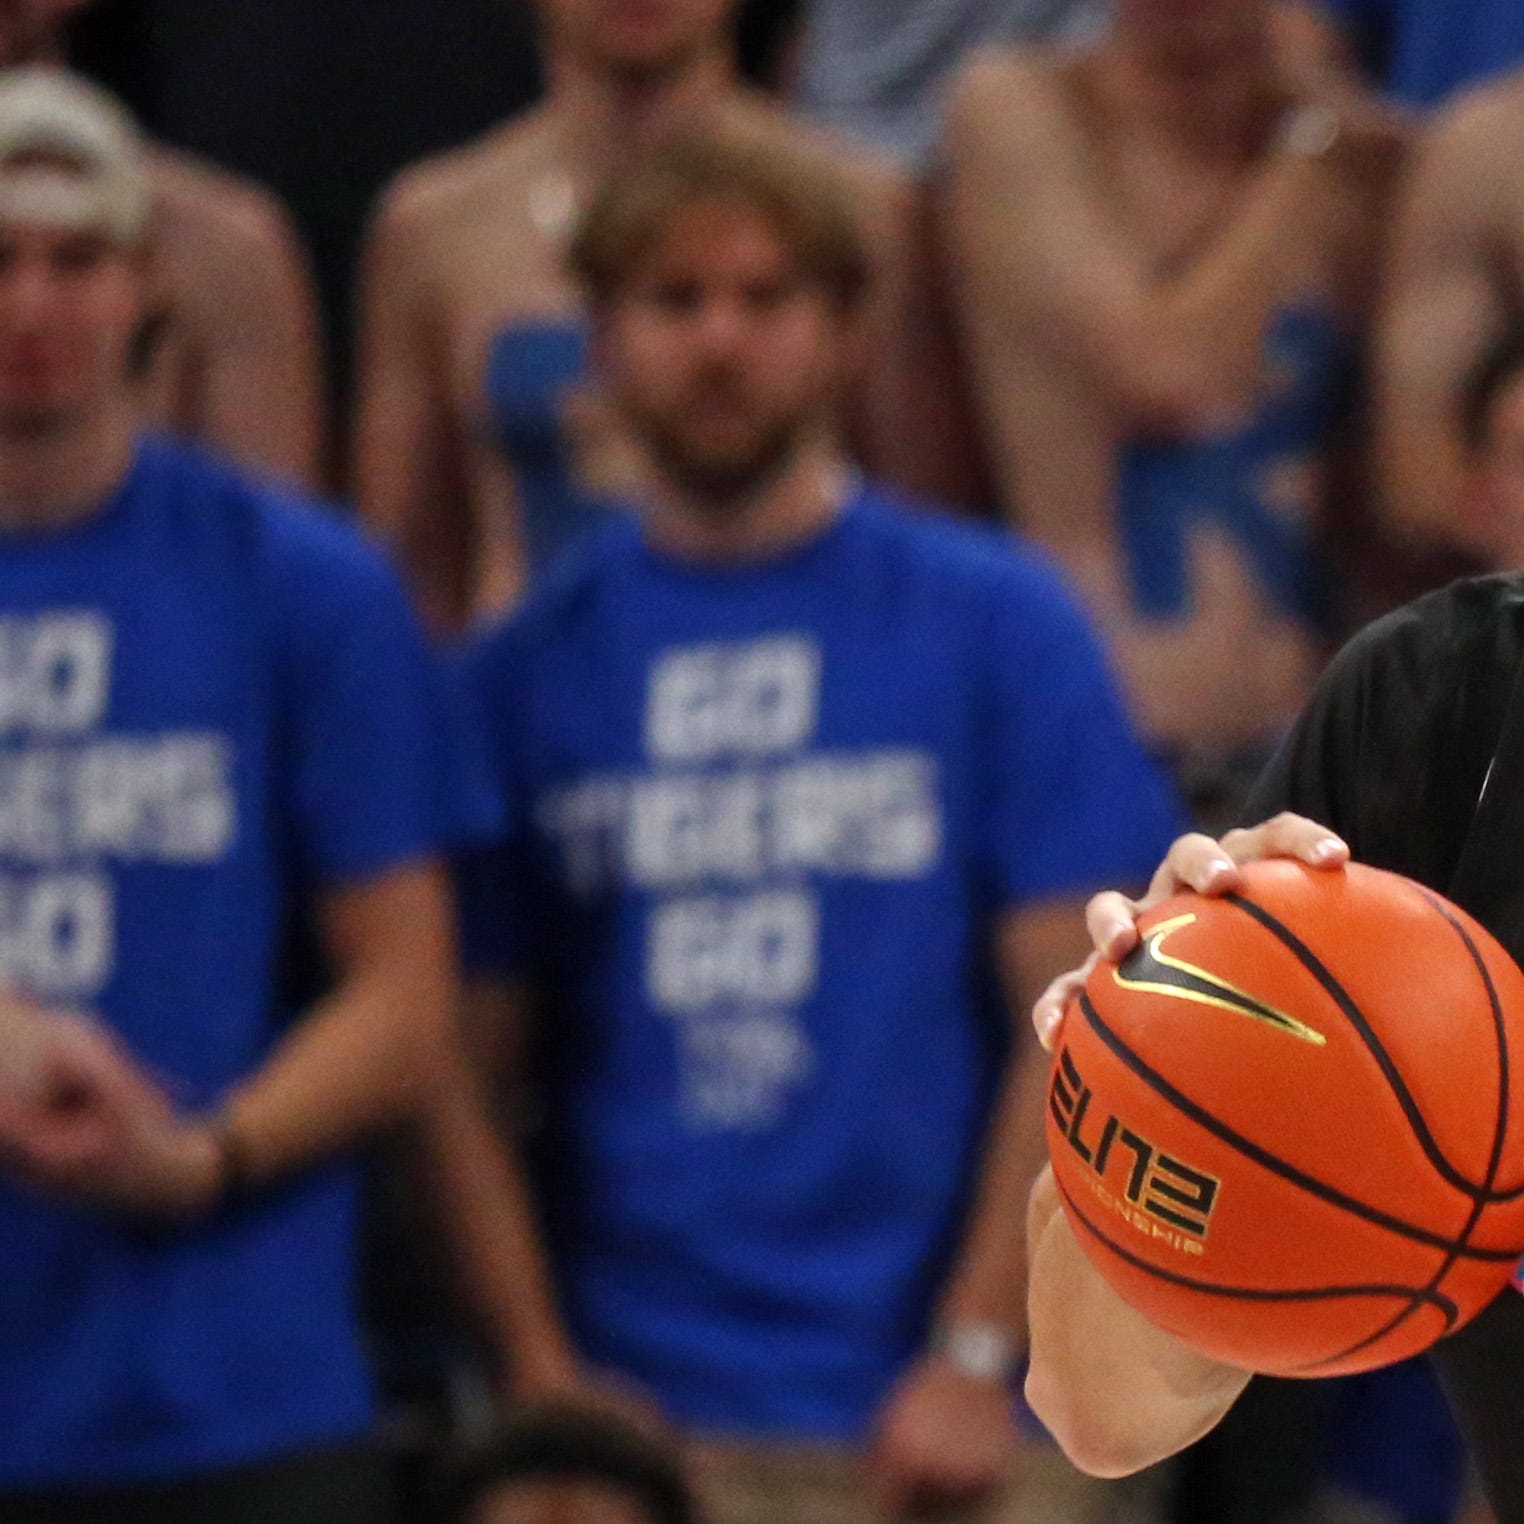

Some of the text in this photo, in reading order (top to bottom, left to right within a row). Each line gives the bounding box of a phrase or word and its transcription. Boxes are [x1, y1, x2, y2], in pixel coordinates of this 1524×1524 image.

[645, 634, 821, 764] GO
[537, 750, 942, 895] TIGERS
[645, 893, 820, 1012] GO
